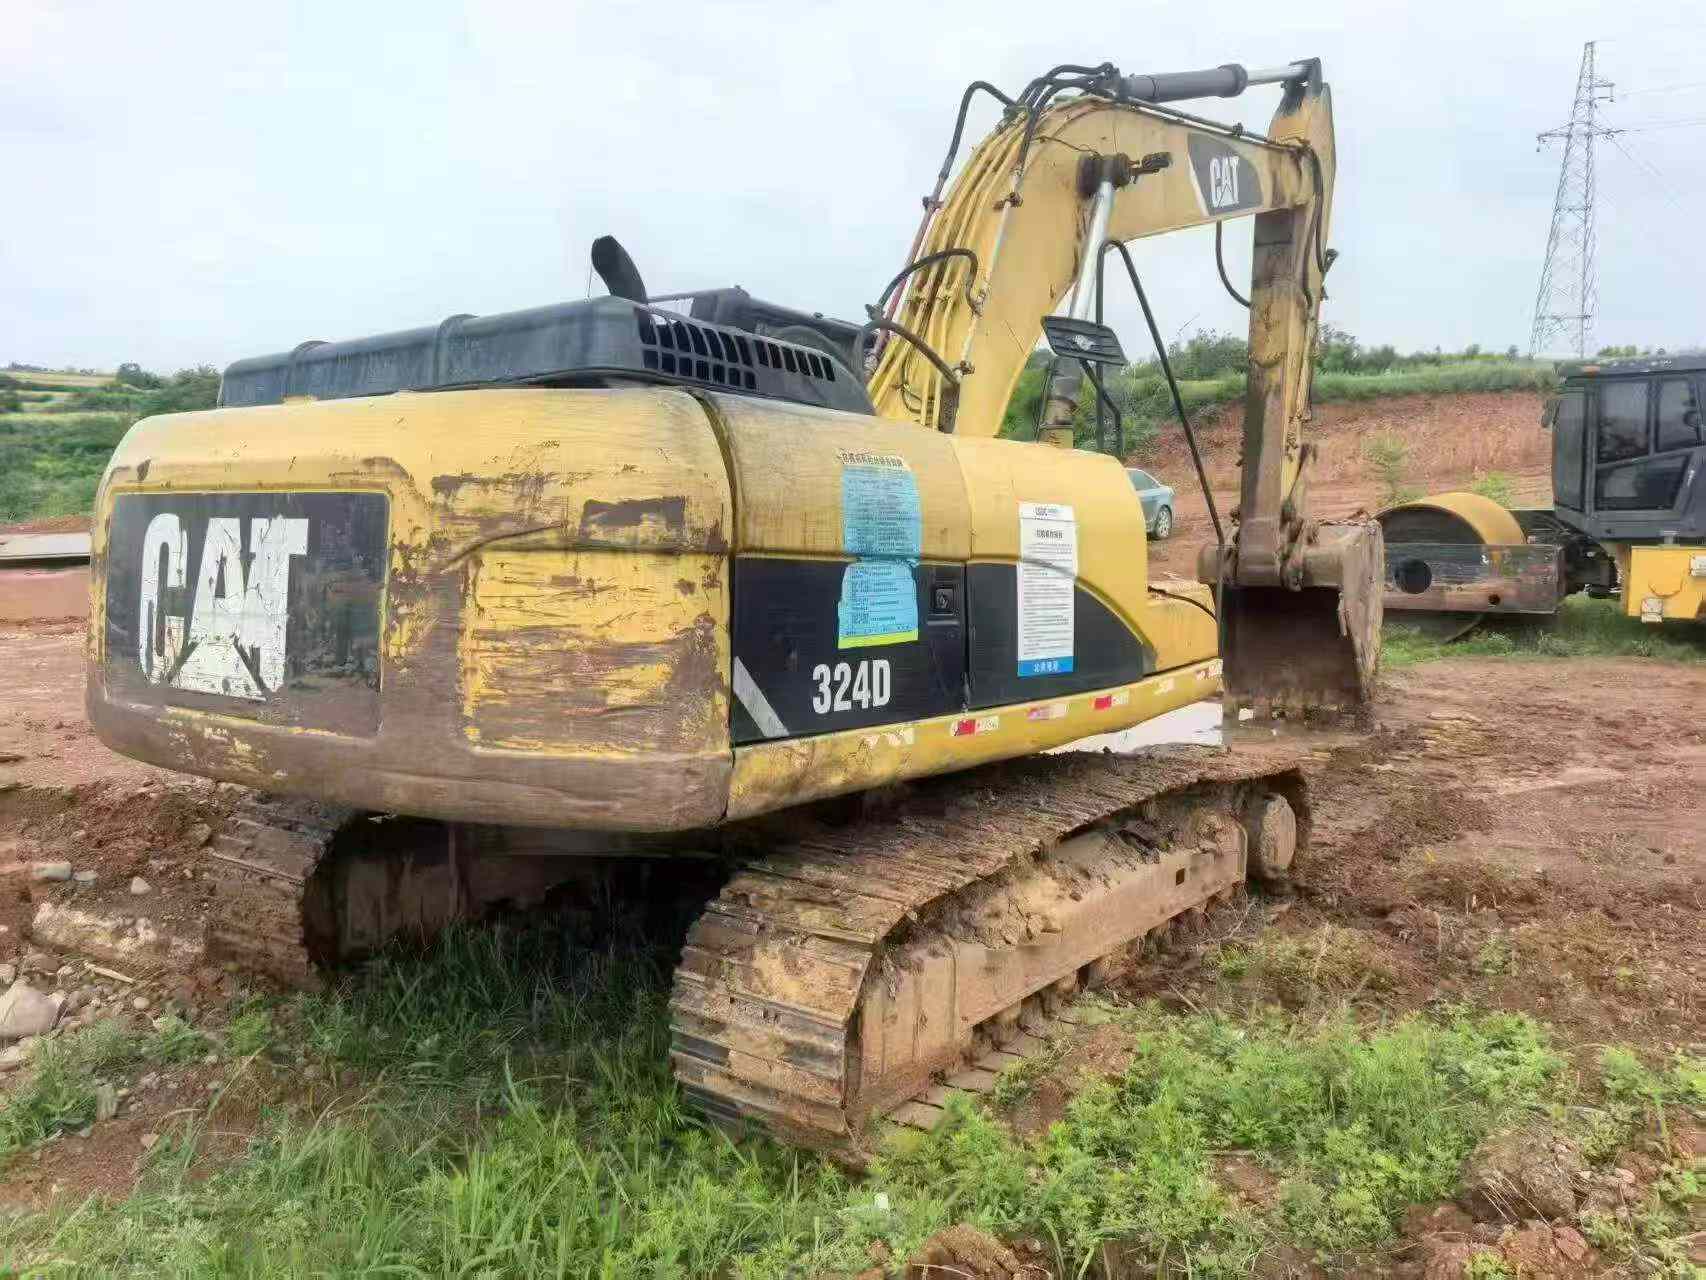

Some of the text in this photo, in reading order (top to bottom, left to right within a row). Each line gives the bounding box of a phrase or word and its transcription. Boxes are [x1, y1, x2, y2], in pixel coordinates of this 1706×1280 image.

[1210, 156, 1240, 208] CAT
[139, 513, 309, 701] CAT
[812, 659, 891, 714] 324D
